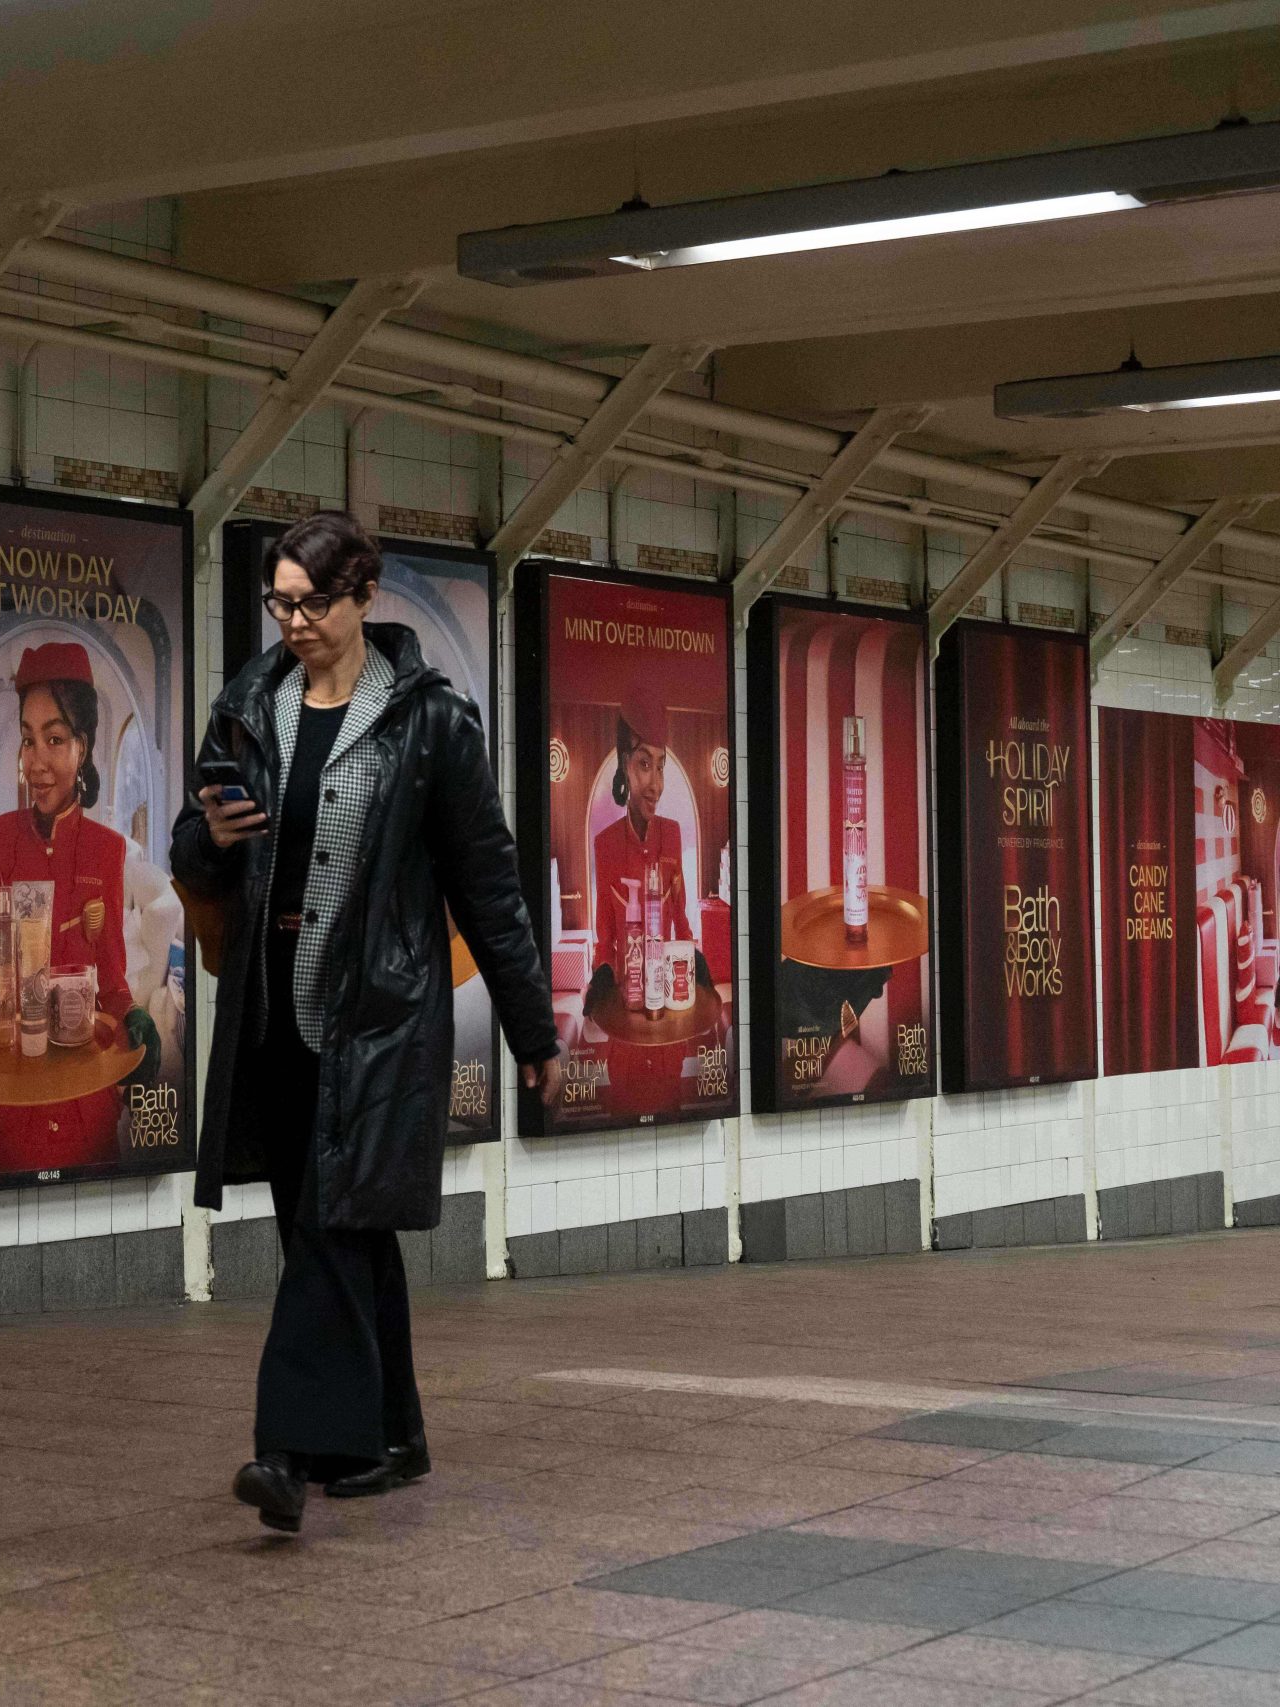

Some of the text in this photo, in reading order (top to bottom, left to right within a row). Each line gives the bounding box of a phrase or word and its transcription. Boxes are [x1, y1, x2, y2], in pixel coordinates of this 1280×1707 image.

[21, 525, 77, 543] destination
[67, 552, 114, 586] DAY
[11, 583, 90, 620] WORK
[95, 591, 141, 624] DAY
[564, 617, 715, 654] MINT OVER MIDTOWN
[1008, 717, 1050, 732] All aboard the
[985, 740, 1070, 782] HOLIDAY
[1002, 780, 1059, 827] SPIRIT
[997, 837, 1064, 849] POWERED BY FRAGRANCE
[1129, 864, 1168, 887] CANDY
[1004, 884, 1060, 932] Bath
[1134, 891, 1165, 913] CANE
[1126, 917, 1173, 940] DREAMS
[1006, 930, 1061, 969] &Body
[1004, 961, 1062, 998] Works
[897, 1023, 926, 1046] Bath
[697, 1043, 727, 1067] Bath
[786, 1036, 832, 1058] HOLIDAY
[794, 1053, 825, 1080] SPIRIT
[898, 1059, 928, 1076] Works
[130, 1082, 177, 1111] Bath
[565, 1076, 600, 1102] SPIRIT
[697, 1079, 728, 1097] Works
[131, 1108, 178, 1130] &Body
[130, 1125, 179, 1148] Works
[38, 1170, 60, 1180] 402-145
